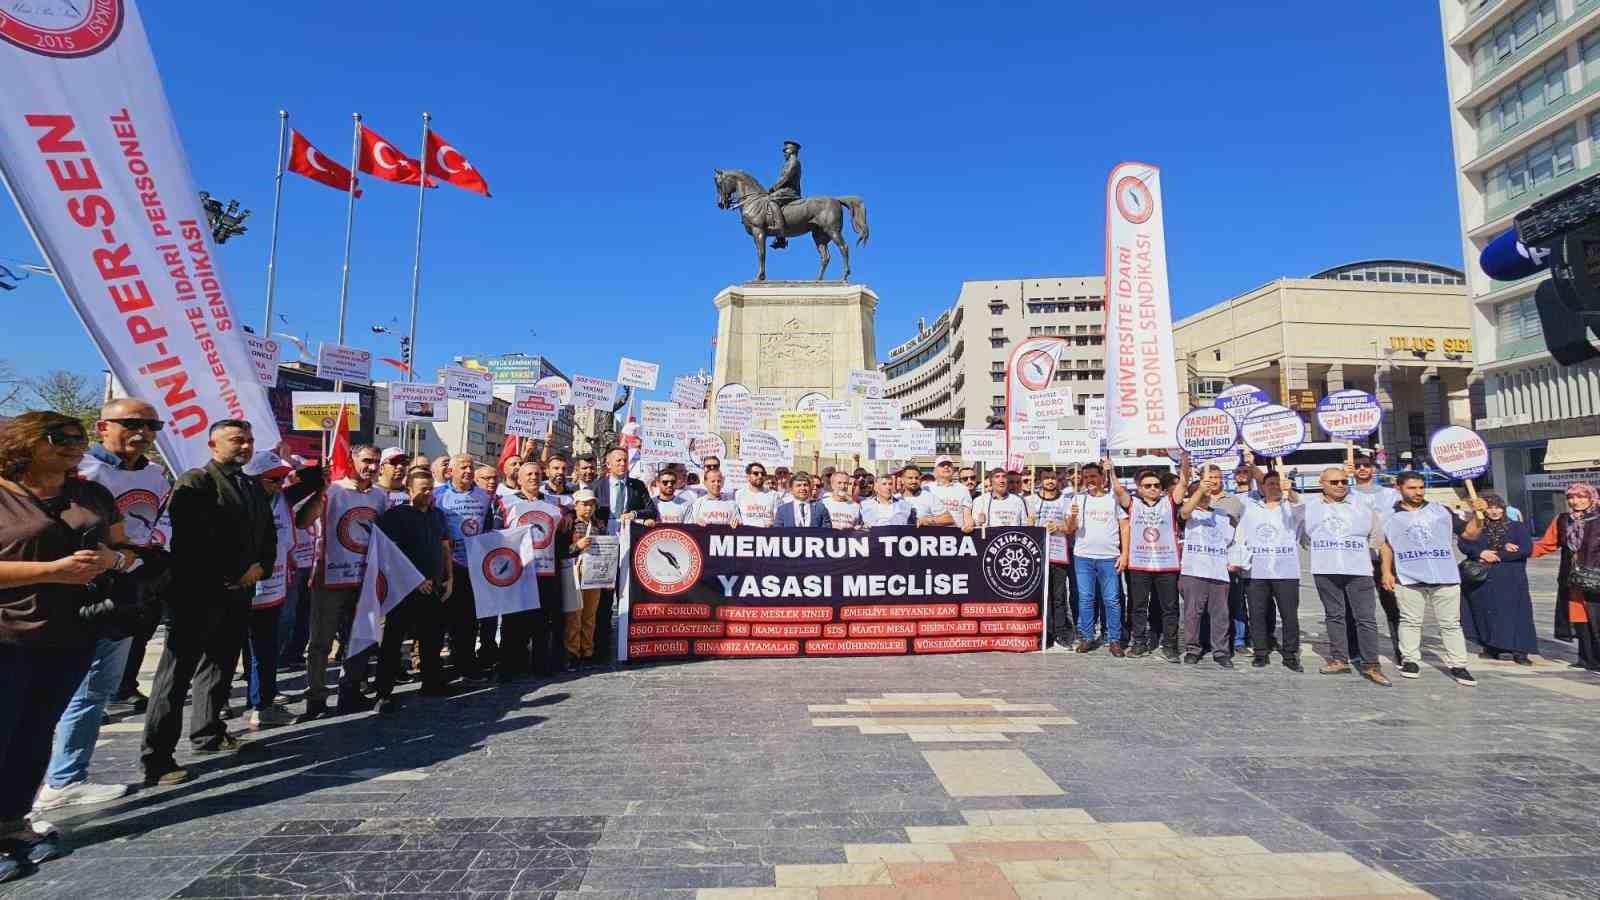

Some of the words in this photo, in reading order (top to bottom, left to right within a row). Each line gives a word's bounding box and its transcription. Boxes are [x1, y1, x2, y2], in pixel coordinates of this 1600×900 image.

[33, 33, 76, 50] 2015
[110, 108, 173, 238] PERSONEL
[24, 114, 209, 440] ÜNİ-PER-SEN
[177, 219, 233, 334] SENDİKASI
[1133, 233, 1157, 334] SENDİKASI
[1389, 336, 1436, 353] ULUS
[1139, 337, 1168, 437] PERSONEL
[1183, 414, 1229, 426] YARDIMCI
[1183, 425, 1231, 438] HİZMETLER
[709, 534, 871, 559] MEMURUN
[879, 535, 978, 557] TORBA
[718, 573, 833, 598] YASASI
[842, 568, 970, 598] MECLİSE
[635, 605, 666, 617] TAYİN
[666, 605, 710, 617] SORUNU
[937, 605, 957, 616] ZAM
[964, 605, 985, 615] 5510
[656, 624, 669, 634] EK
[671, 622, 722, 634] GÖSTERGE
[753, 625, 780, 635] KAMU
[887, 623, 914, 634] MESAİ
[653, 641, 686, 653] MOBİL
[743, 642, 797, 652] ATAMALAR
[808, 641, 836, 651] KAMU
